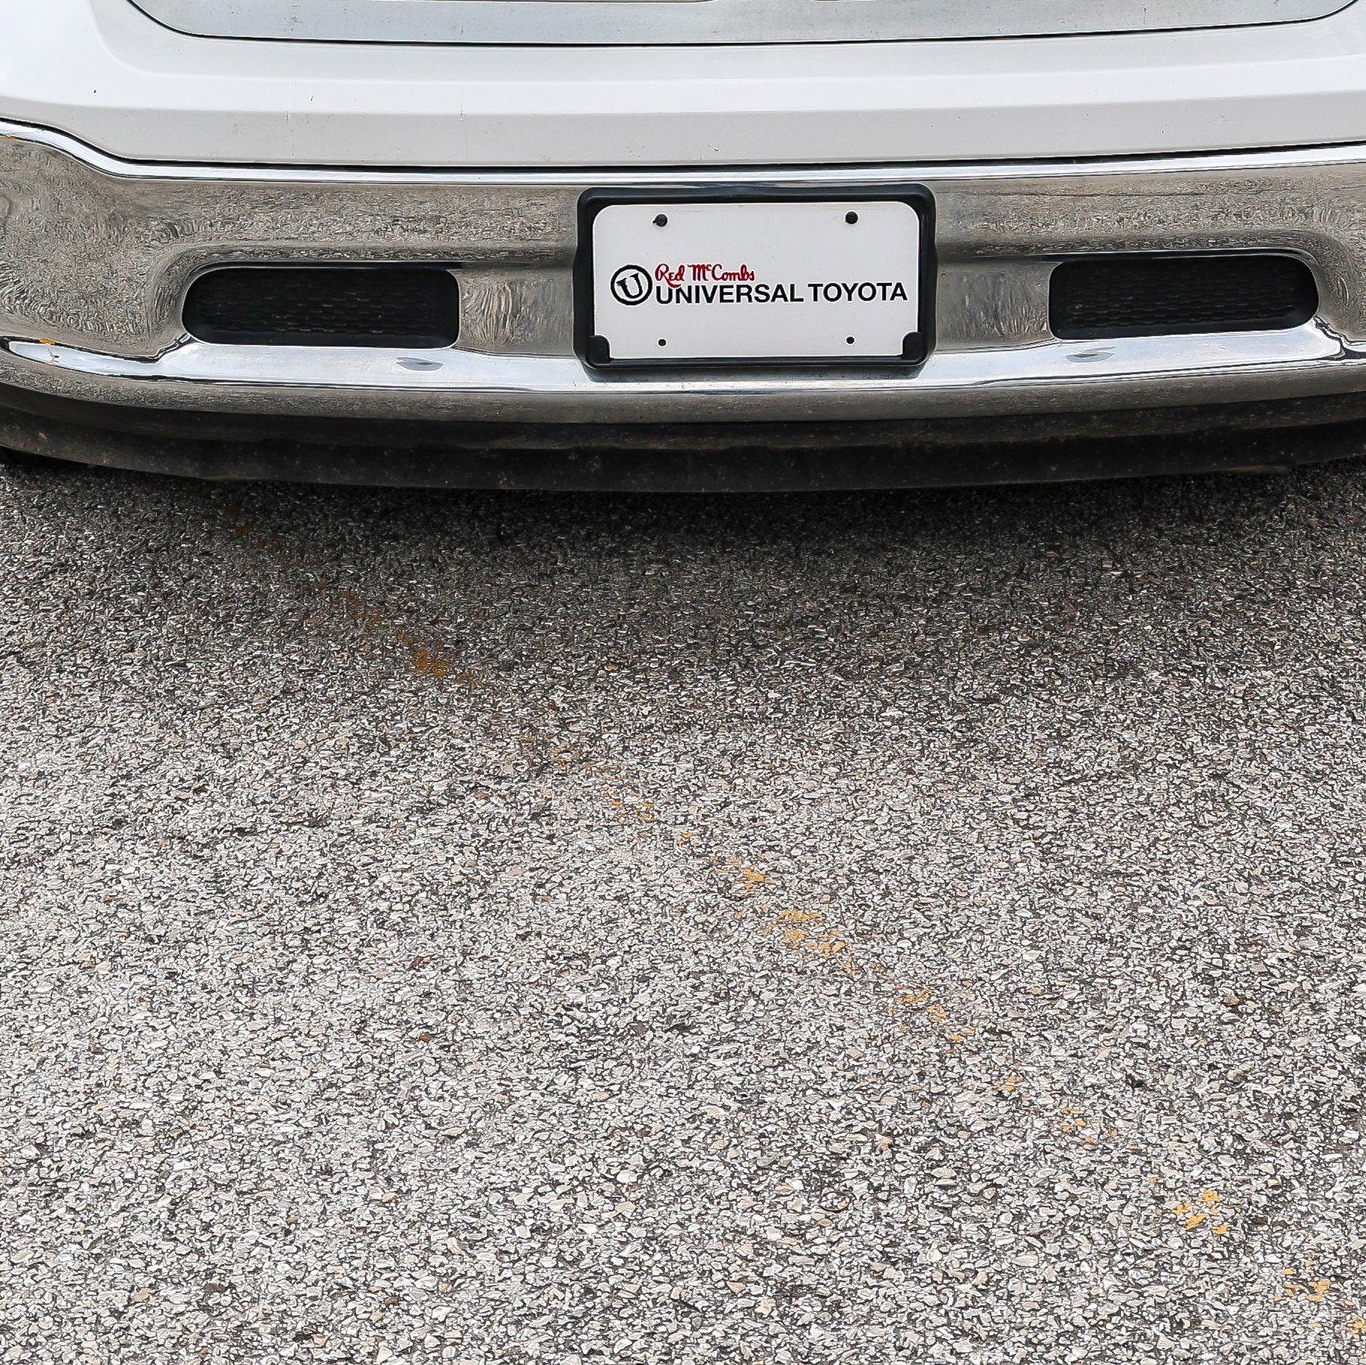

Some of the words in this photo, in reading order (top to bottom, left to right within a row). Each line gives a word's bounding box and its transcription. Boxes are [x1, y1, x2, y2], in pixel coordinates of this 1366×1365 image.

[655, 263, 685, 289] Red
[687, 263, 755, 281] McCombs
[656, 284, 804, 304] UNIVERSAL
[808, 282, 908, 302] TOYOTA
